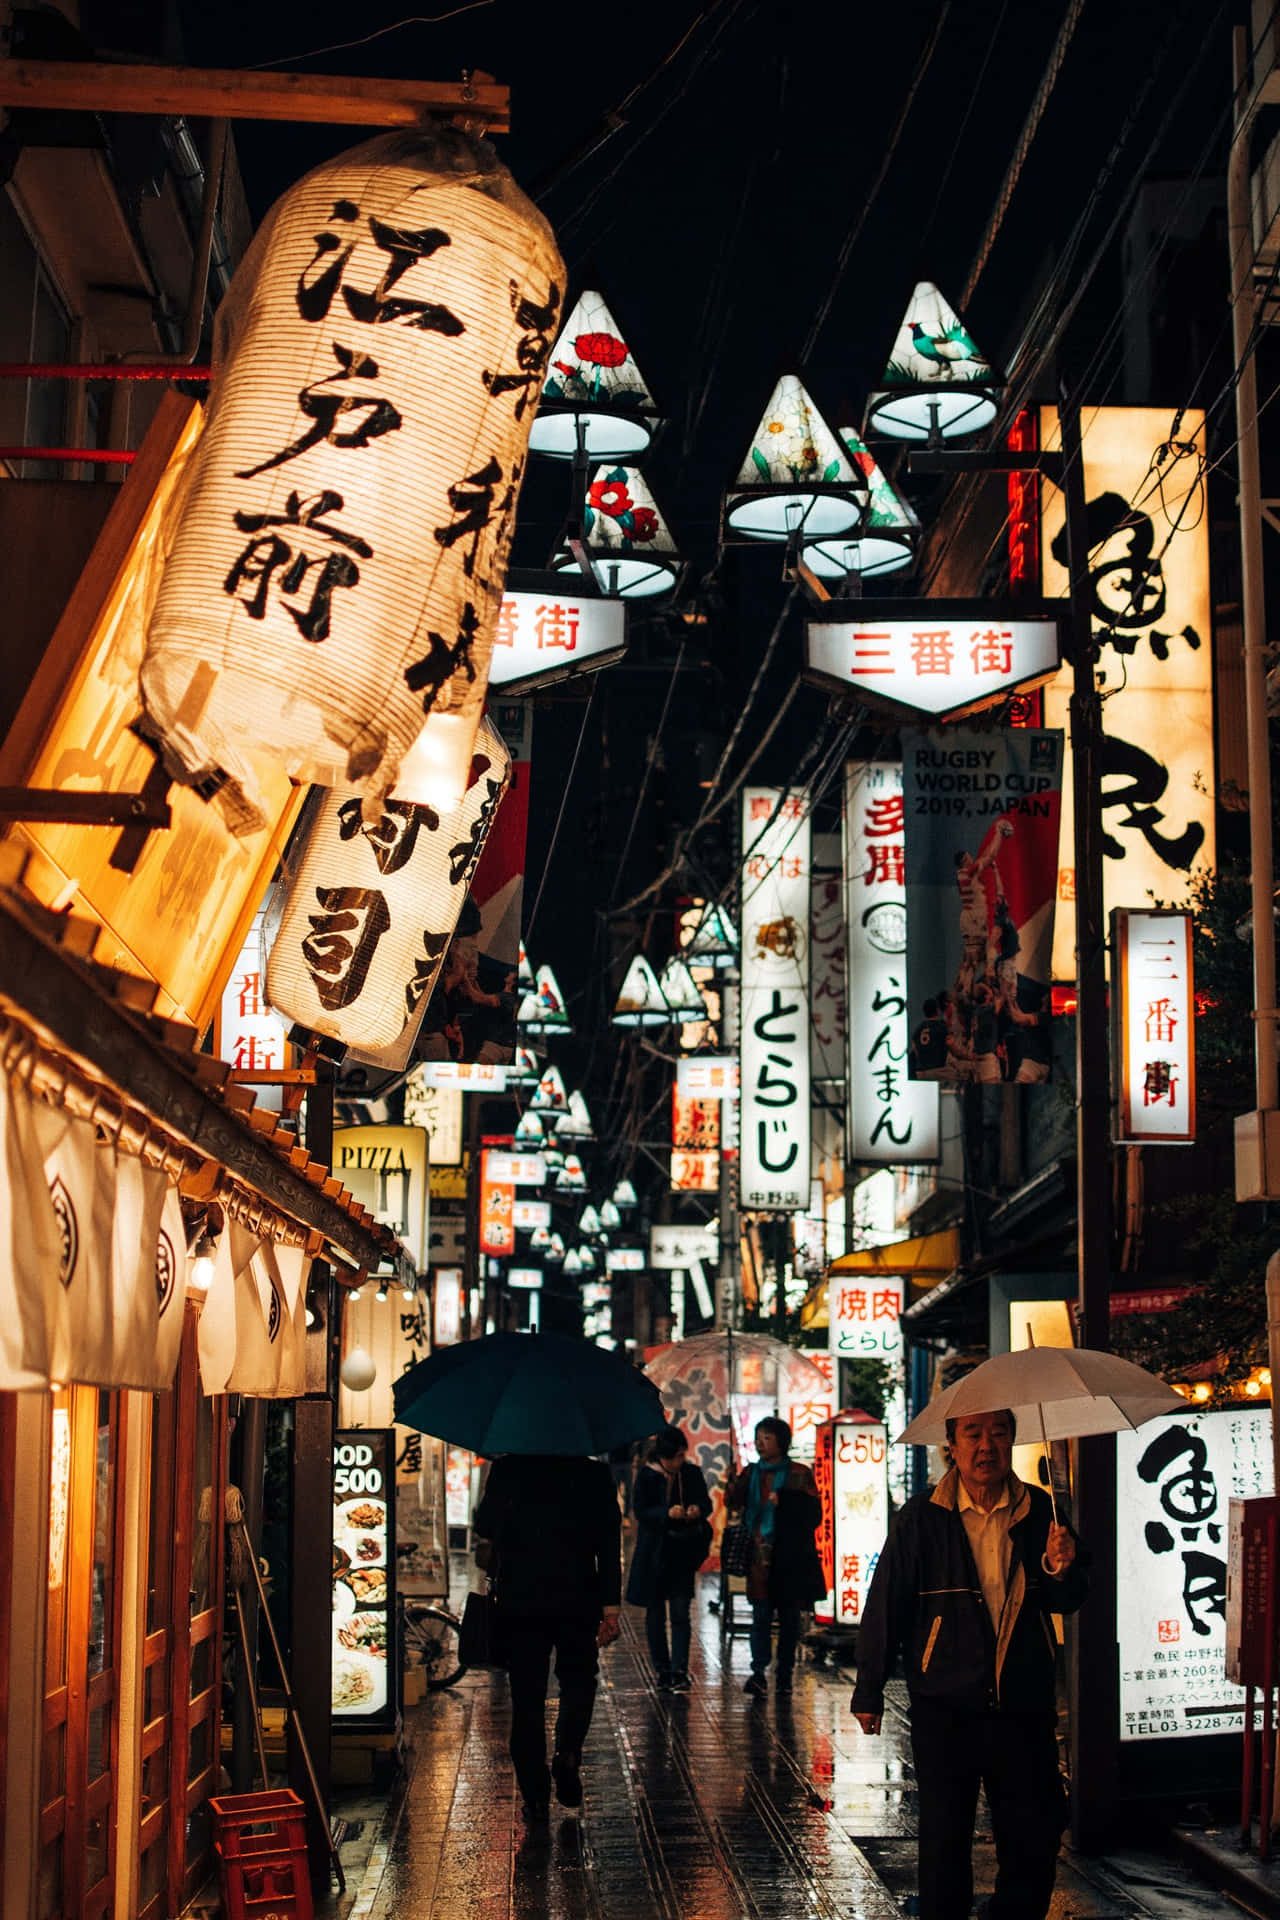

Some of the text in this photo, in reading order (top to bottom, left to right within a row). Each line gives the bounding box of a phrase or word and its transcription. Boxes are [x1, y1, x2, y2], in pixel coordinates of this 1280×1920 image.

[223, 200, 467, 643] 江戸前
[851, 629, 1013, 676] 三番街
[914, 751, 995, 769] RUGBY
[914, 773, 1051, 793] WORLD CUP
[977, 797, 1050, 818] JAPAN
[868, 977, 912, 1147] らんまん
[754, 989, 799, 1173] とらじ
[341, 1147, 407, 1174] PIZZA
[749, 1191, 800, 1206] 中野店
[838, 1288, 900, 1321] 焼肉
[838, 1330, 899, 1352] とらじ
[334, 1445, 373, 1467] OD
[837, 1433, 885, 1464] とらじ
[334, 1468, 382, 1494] 500
[841, 1553, 860, 1617] 焼肉
[1125, 1709, 1175, 1723] 営業時間
